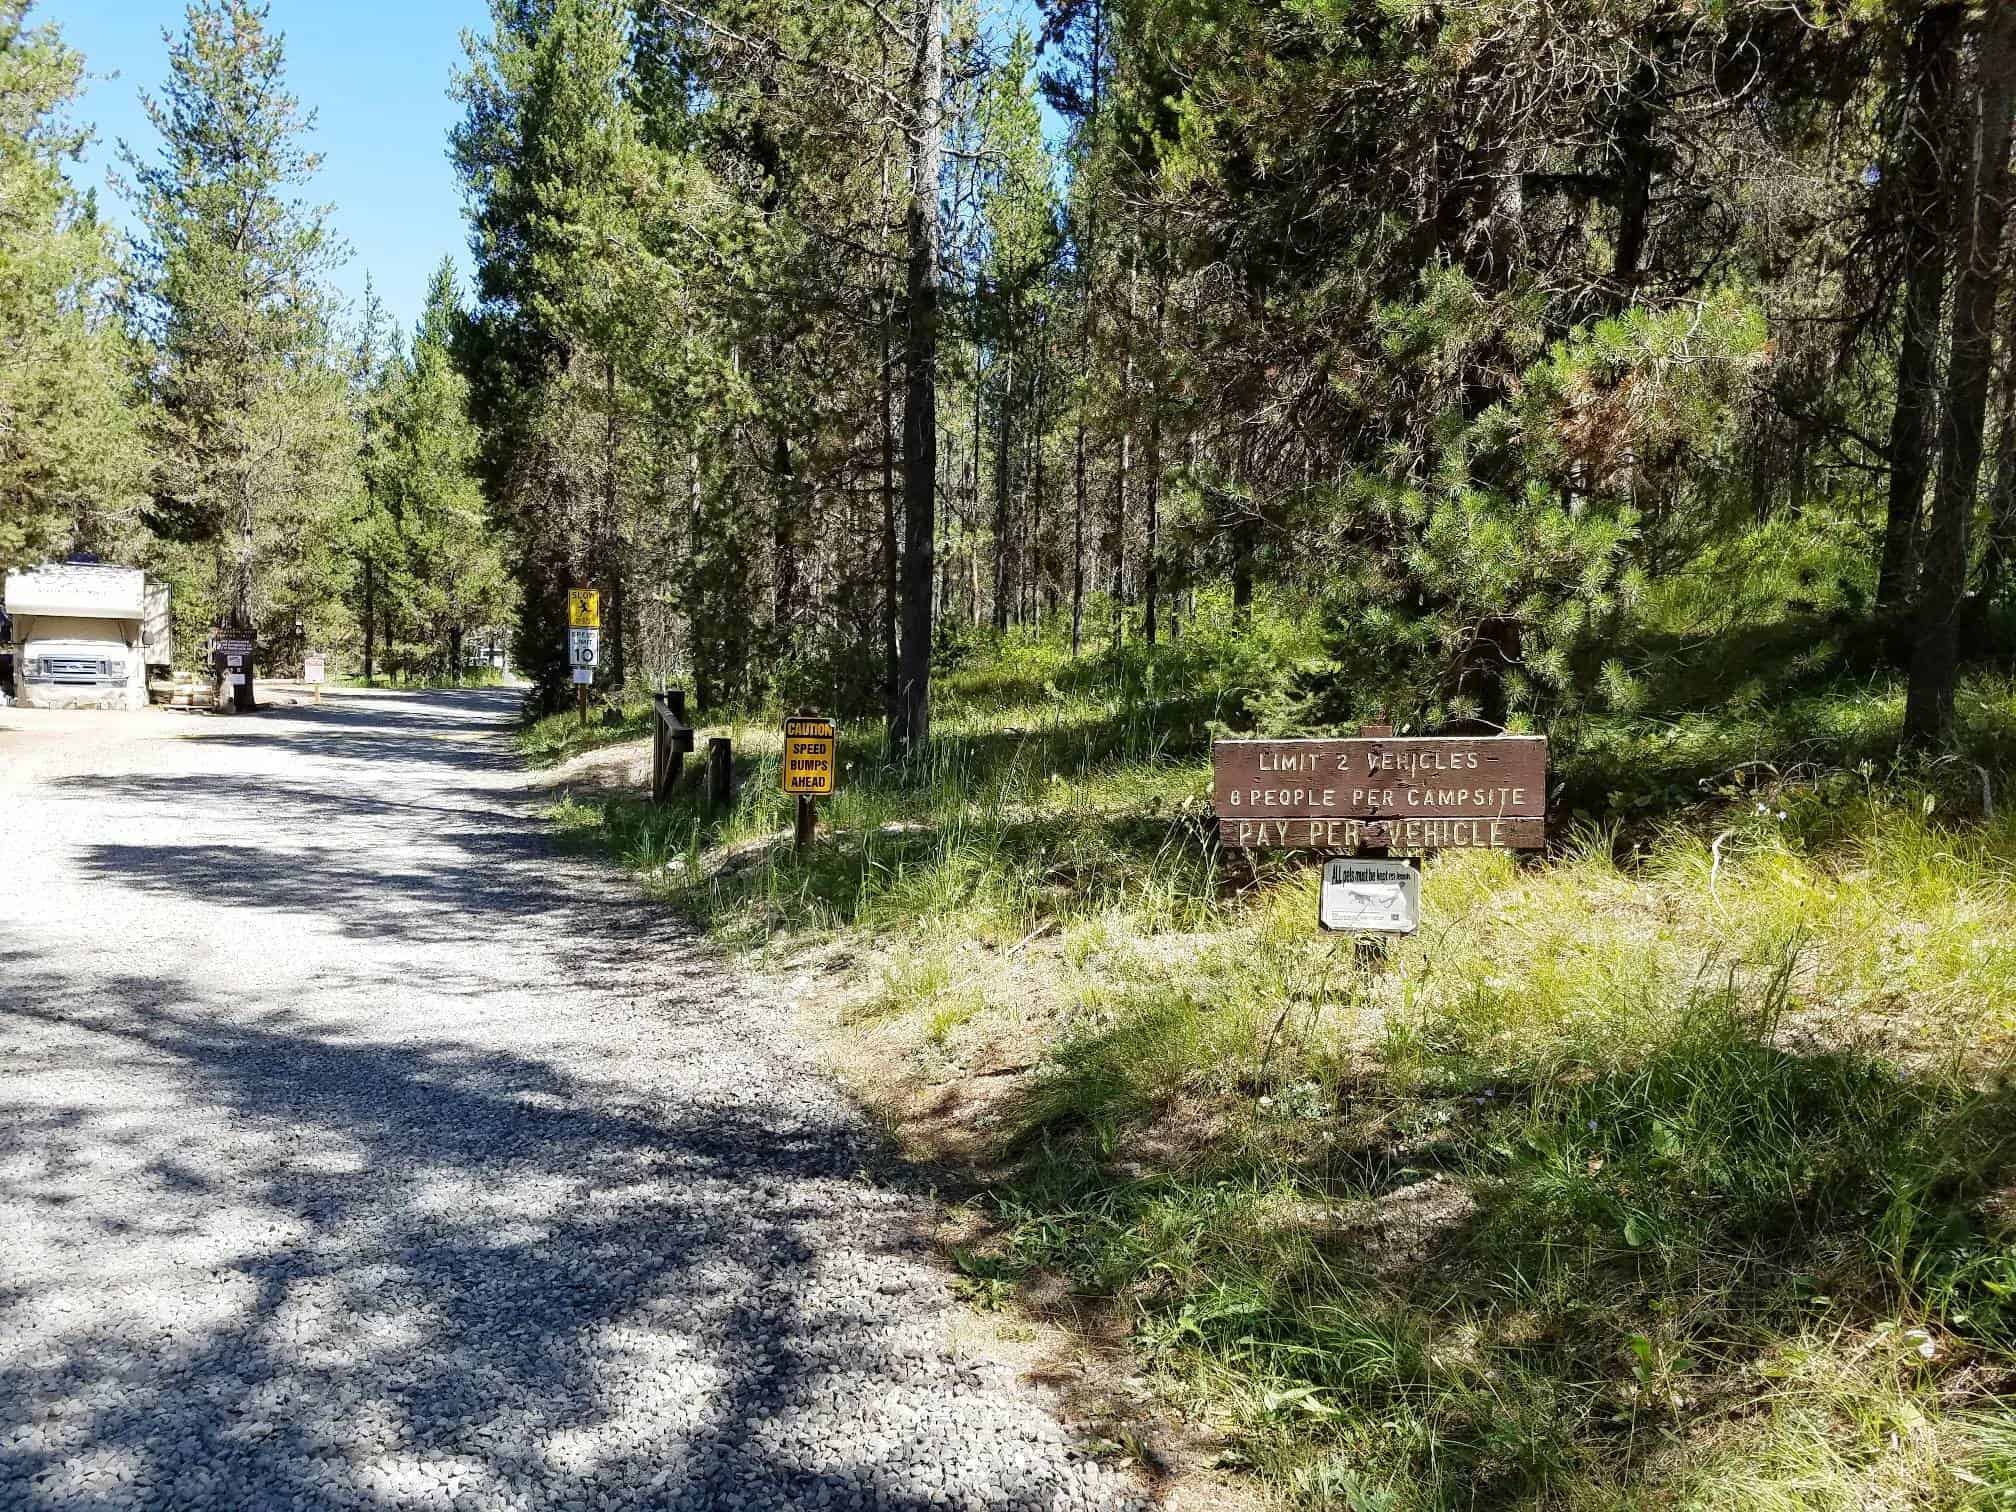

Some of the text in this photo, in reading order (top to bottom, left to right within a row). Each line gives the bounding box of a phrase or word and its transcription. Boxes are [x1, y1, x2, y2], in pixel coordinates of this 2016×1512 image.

[571, 591, 595, 600] SLOW
[575, 648, 594, 662] 10
[787, 722, 833, 737] CAUTION
[793, 743, 826, 755] SPEED
[790, 759, 828, 771] BUMPS
[1259, 752, 1320, 771] LIMIT
[1337, 754, 1351, 771] 2
[1367, 752, 1479, 772] VEHICLES
[791, 776, 826, 788] AHEAD
[1230, 788, 1527, 807] 8 PEOPLE PER CAMPSITE
[1239, 820, 1507, 847] PAY PER VEHICLE
[1331, 864, 1342, 885] ALL
[1342, 866, 1355, 887] pets
